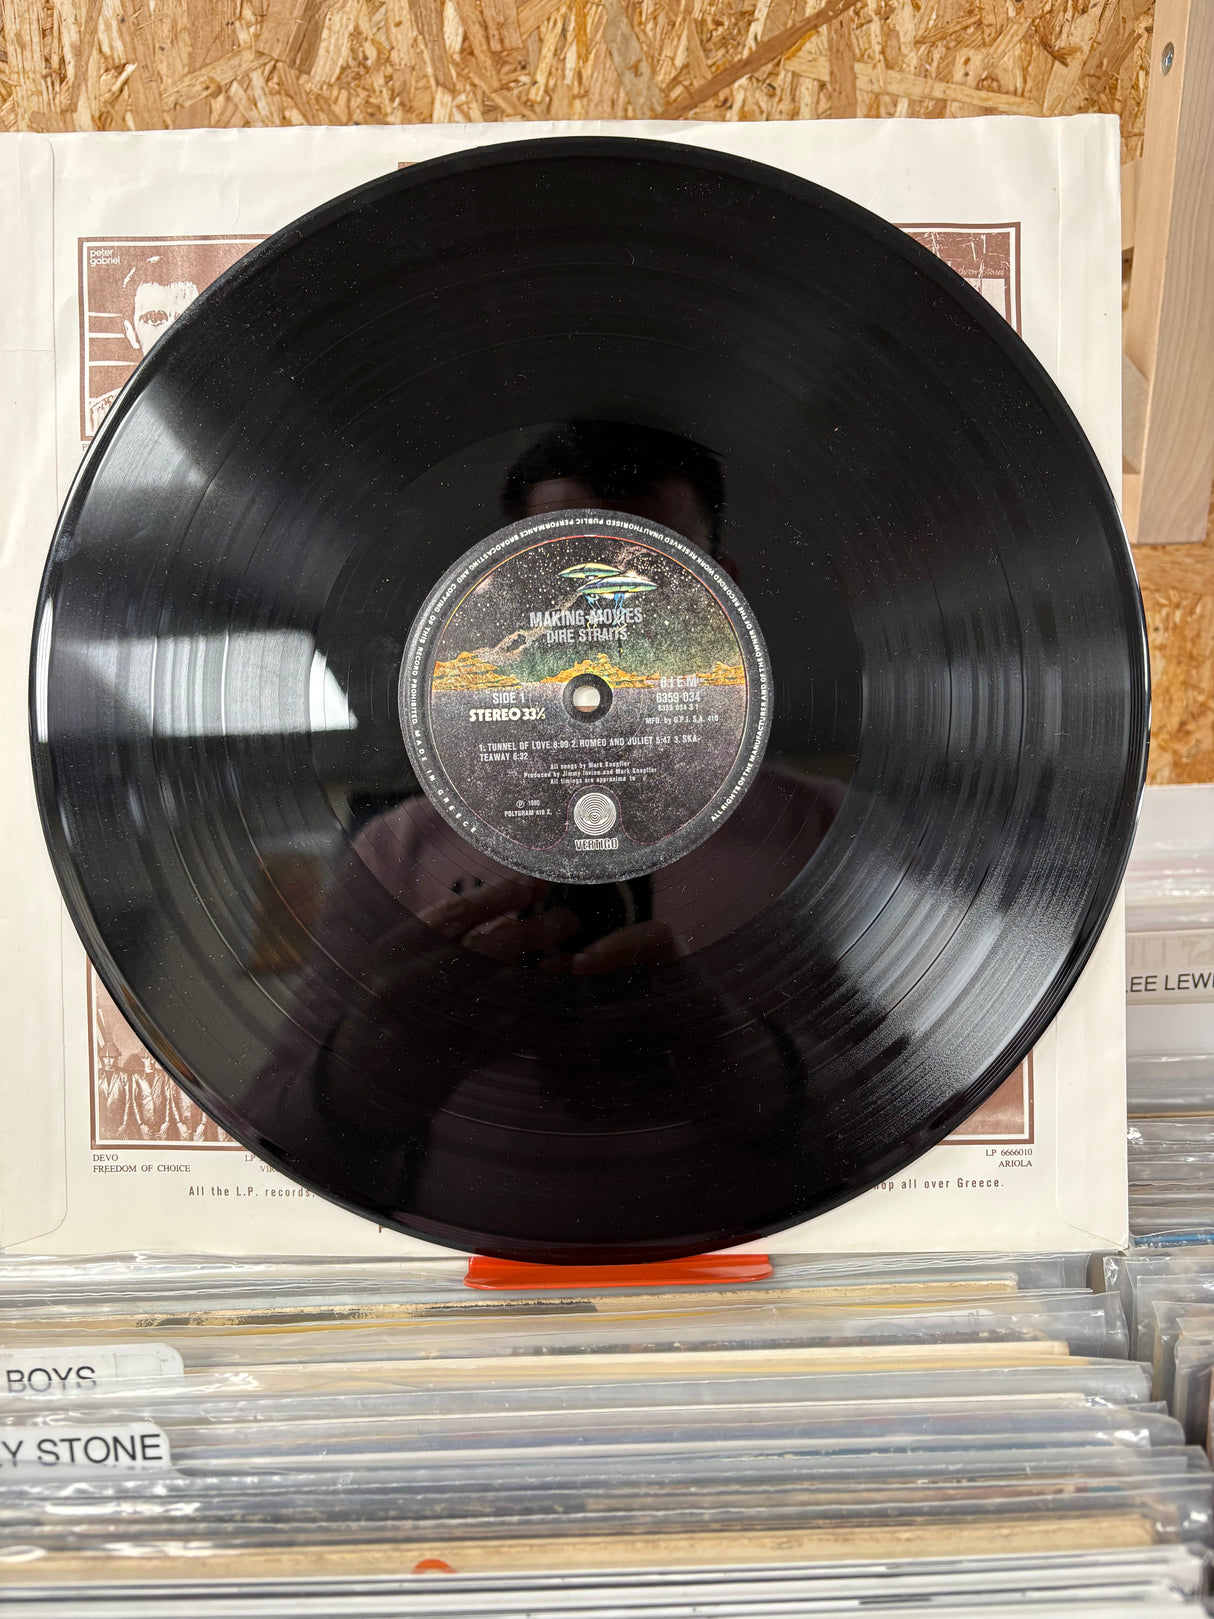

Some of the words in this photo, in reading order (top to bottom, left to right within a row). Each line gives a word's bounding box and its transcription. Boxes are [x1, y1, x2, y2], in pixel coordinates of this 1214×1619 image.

[90, 247, 114, 258] peter
[90, 256, 121, 267] gabriel
[518, 519, 573, 538] PERFORMANCE
[605, 519, 663, 540] UNAUTHORISED
[467, 533, 518, 571] BROADCASTING
[663, 536, 697, 560] RESERVED
[694, 557, 715, 576] WORK
[455, 568, 470, 583] AND
[433, 582, 457, 613] COPYING
[712, 573, 740, 607] RECORDED
[426, 614, 436, 625] OF
[529, 609, 585, 627] MAKING
[588, 607, 643, 625] MOVIES
[742, 618, 752, 630] OF
[419, 626, 430, 644] THIS
[546, 629, 575, 643] DIRE
[578, 627, 628, 642] STRAITS
[747, 629, 761, 657] OWNER
[411, 646, 423, 675] RECORD
[758, 672, 765, 682] OF
[492, 692, 517, 704] SIDE
[519, 692, 525, 703] 1
[656, 692, 680, 703] 6359
[682, 691, 701, 702] 034
[469, 708, 521, 722] STEREO
[748, 701, 766, 762] MANUFACTURER
[487, 742, 517, 752] TUNNEL
[519, 741, 529, 750] OF
[531, 740, 551, 750] LOVE
[579, 738, 607, 748] ROMEO
[609, 738, 625, 747] AND
[627, 736, 653, 746] JULIET
[480, 753, 510, 762] TEAWAY
[523, 770, 552, 779] Produced
[615, 767, 630, 775] Mark
[736, 775, 746, 786] OF
[413, 729, 427, 762] MADE
[426, 769, 436, 782] IN
[436, 788, 477, 833] GREECE
[720, 784, 741, 811] RIGHTS
[710, 808, 724, 822] ALL
[574, 837, 619, 851] VERTIGO
[1126, 974, 1158, 993] EE
[92, 1153, 119, 1162] DEVO
[985, 1149, 997, 1157] LP
[1000, 1148, 1033, 1156] 6666010
[93, 1164, 137, 1173] FREEDOM
[140, 1164, 154, 1173] OF
[156, 1164, 191, 1173] CHOICE
[998, 1159, 1033, 1168] ARIOLA
[188, 1186, 205, 1196] All
[211, 1186, 230, 1196] the
[236, 1187, 259, 1196] L.P.
[901, 1179, 917, 1189] all
[924, 1180, 950, 1189] over
[957, 1178, 1004, 1188] Greece.
[6, 1366, 97, 1393] BOYS
[37, 1434, 163, 1466] STONE
